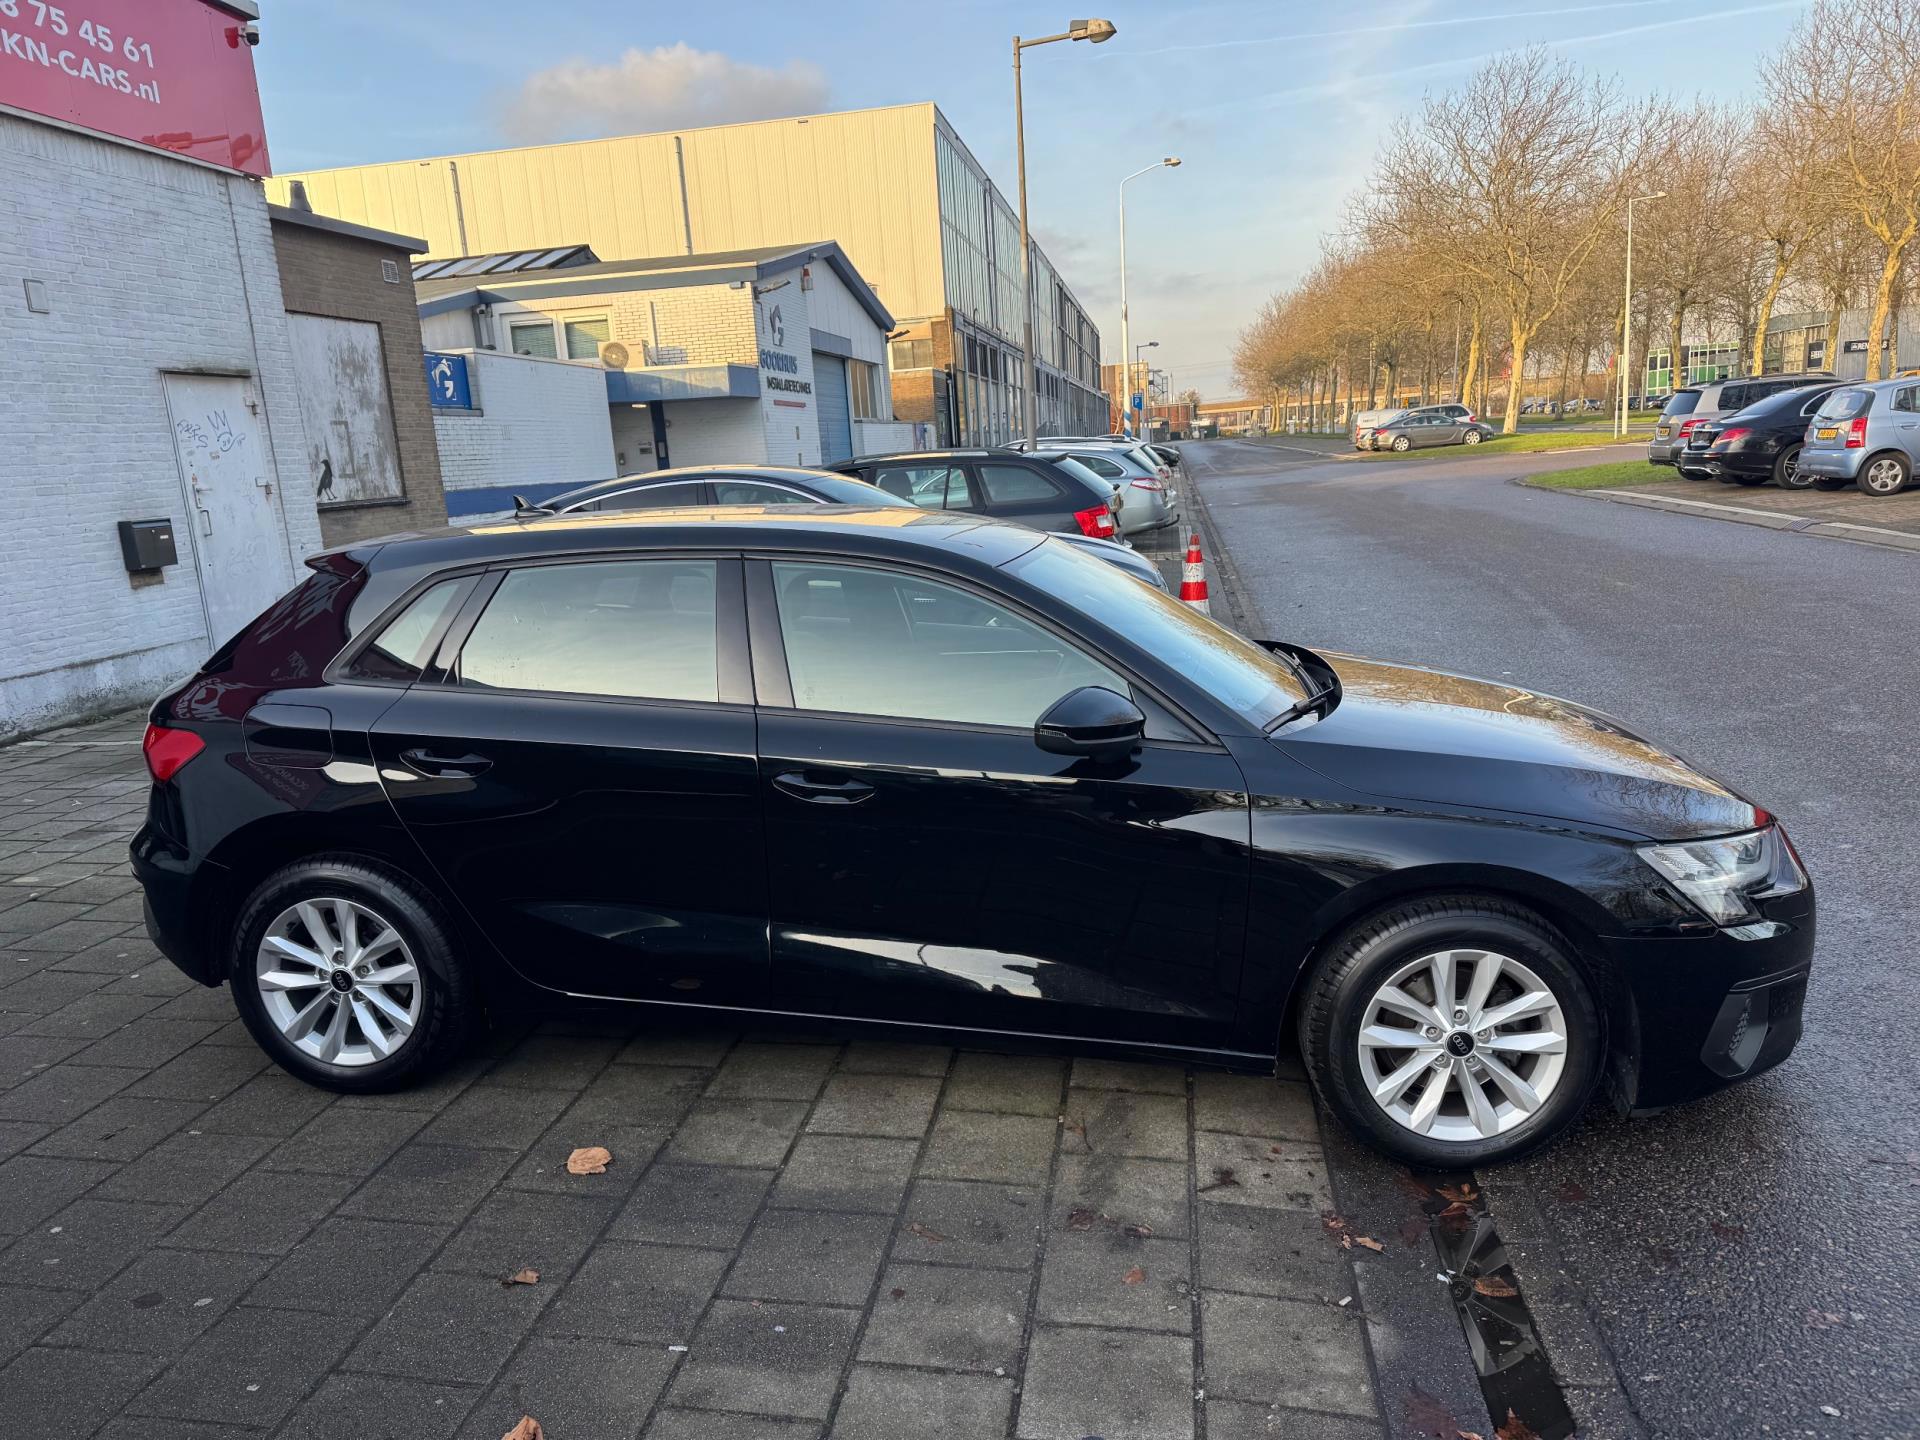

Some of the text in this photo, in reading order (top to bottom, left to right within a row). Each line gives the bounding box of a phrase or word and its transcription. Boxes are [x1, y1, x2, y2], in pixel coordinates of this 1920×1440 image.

[27, 0, 68, 36] 75
[79, 19, 114, 53] 45
[123, 36, 154, 69] 61
